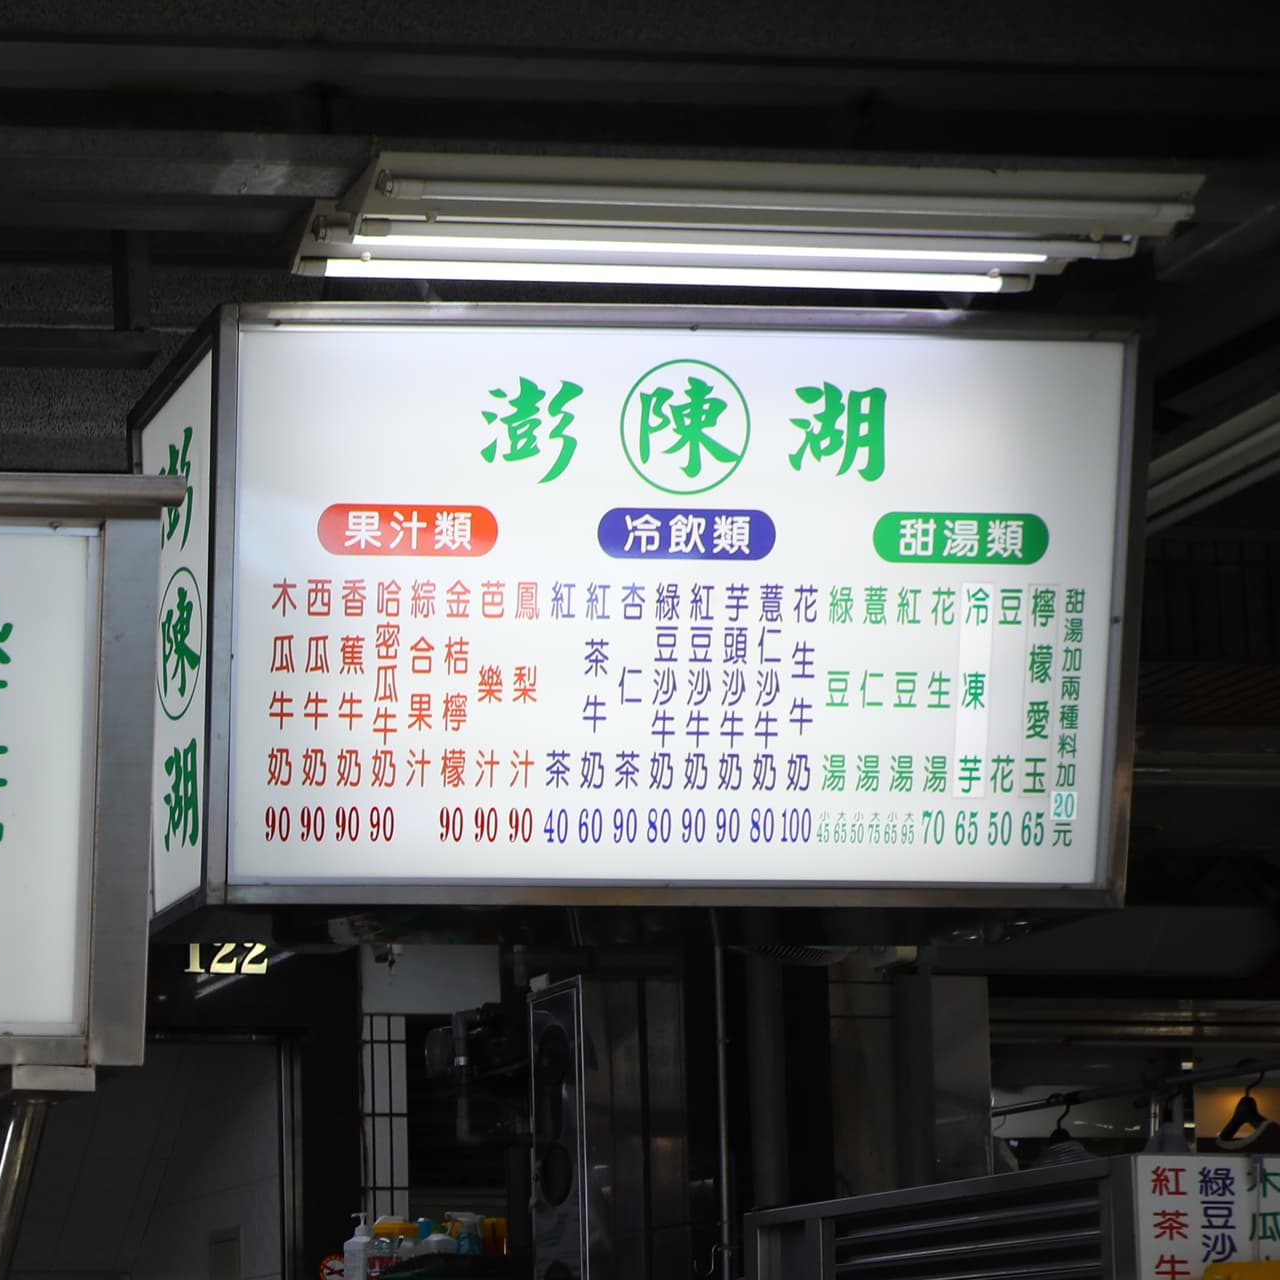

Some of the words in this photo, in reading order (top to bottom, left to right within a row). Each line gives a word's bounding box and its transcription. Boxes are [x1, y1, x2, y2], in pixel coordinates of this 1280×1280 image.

[343, 510, 472, 551] 果汁類
[623, 513, 751, 555] 冷飲類
[898, 517, 1024, 559] 甜湯類
[267, 577, 297, 786] 木瓜牛奶
[301, 578, 332, 786] 西瓜牛奶
[336, 578, 367, 786] 香蕉牛奶
[371, 579, 402, 787] 哈密瓜牛奶
[405, 579, 436, 787] 綜合果汁
[440, 579, 471, 787] 金桔檸檬
[475, 580, 506, 788] 芭樂汁
[509, 580, 539, 788] 鳳梨汁
[580, 581, 611, 790] 紅茶牛奶
[615, 582, 646, 789] 杏仁茶
[648, 582, 680, 790] 綠豆沙牛奶
[683, 582, 715, 790] 紅豆沙牛奶
[717, 583, 750, 791] 芋頭沙牛奶
[751, 583, 784, 791] 薏仁沙牛奶
[786, 584, 818, 791] 花生牛奶
[821, 585, 854, 792] 綠豆湯
[855, 585, 888, 792] 薏仁湯
[889, 586, 922, 792] 紅豆湯
[922, 586, 956, 793] 花生湯
[958, 587, 990, 794] 冷凍芋
[1022, 587, 1056, 794] 檸檬愛玉
[265, 806, 290, 842] 90
[300, 806, 325, 842] 90
[335, 806, 360, 842] 90
[370, 806, 394, 842] 90
[439, 806, 463, 842] 90
[474, 806, 498, 842] 90
[509, 807, 533, 843] 90
[544, 808, 568, 844] 40
[578, 808, 602, 844] 60
[613, 808, 637, 844] 90
[647, 808, 671, 844] 80
[681, 808, 706, 844] 90
[716, 808, 740, 844] 90
[750, 808, 774, 844] 80
[781, 808, 812, 844] 100
[816, 823, 830, 844] 45
[833, 823, 847, 844] 65
[850, 823, 864, 844] 50
[868, 823, 881, 844] 75
[884, 823, 897, 844] 65
[901, 823, 915, 844] 95
[922, 810, 945, 845] 70
[955, 810, 978, 846] 65
[988, 811, 1012, 846] 50
[1021, 811, 1044, 846] 65
[184, 942, 269, 975] 122
[1246, 1168, 1280, 1260] 木瓜
